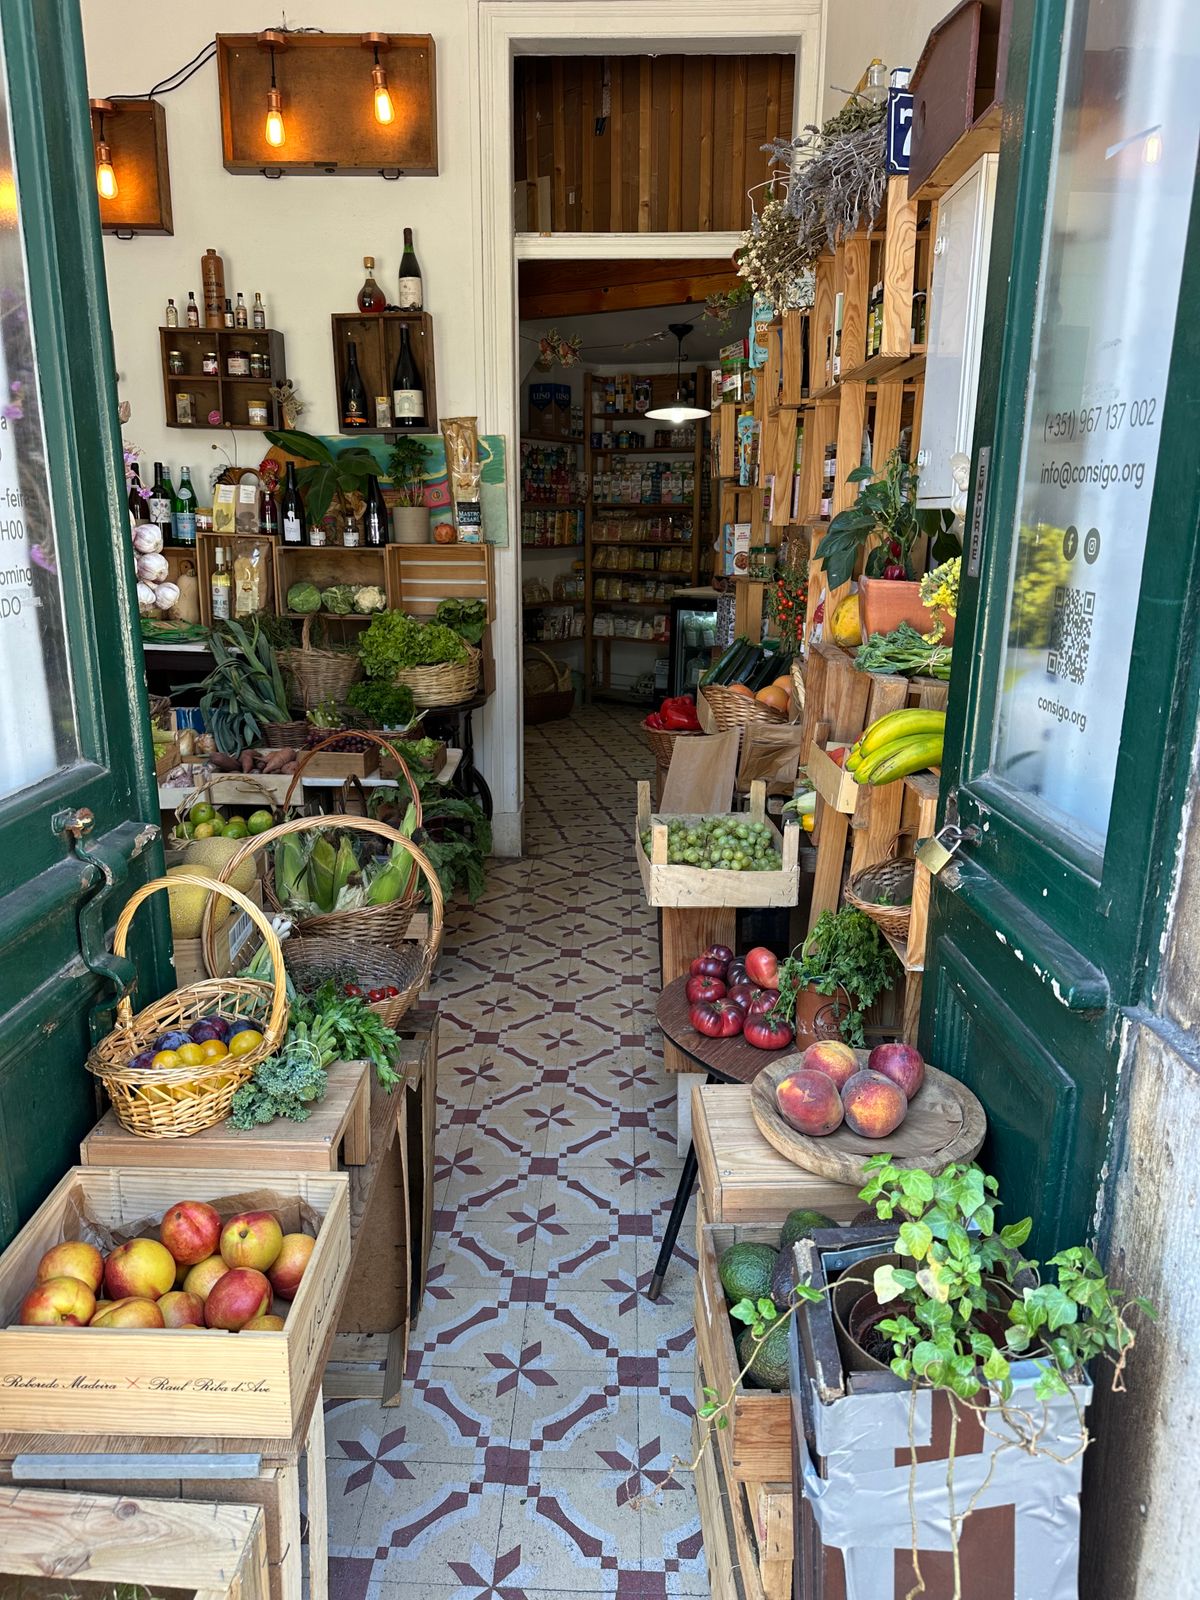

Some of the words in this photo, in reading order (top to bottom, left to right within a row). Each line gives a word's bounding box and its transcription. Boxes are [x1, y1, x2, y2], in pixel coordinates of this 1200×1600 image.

[1044, 408, 1075, 443] (+351)
[1079, 406, 1102, 434] 967
[1105, 402, 1127, 432] 137
[1129, 397, 1157, 428] 002
[1040, 458, 1146, 490] info@consigo.org
[971, 465, 985, 560] EMPURRE
[0, 596, 21, 618] DO
[1037, 695, 1087, 733] consigo.org
[62, 1375, 117, 1390] Madeira
[147, 1376, 192, 1392] Raul
[192, 1377, 229, 1393] Riba
